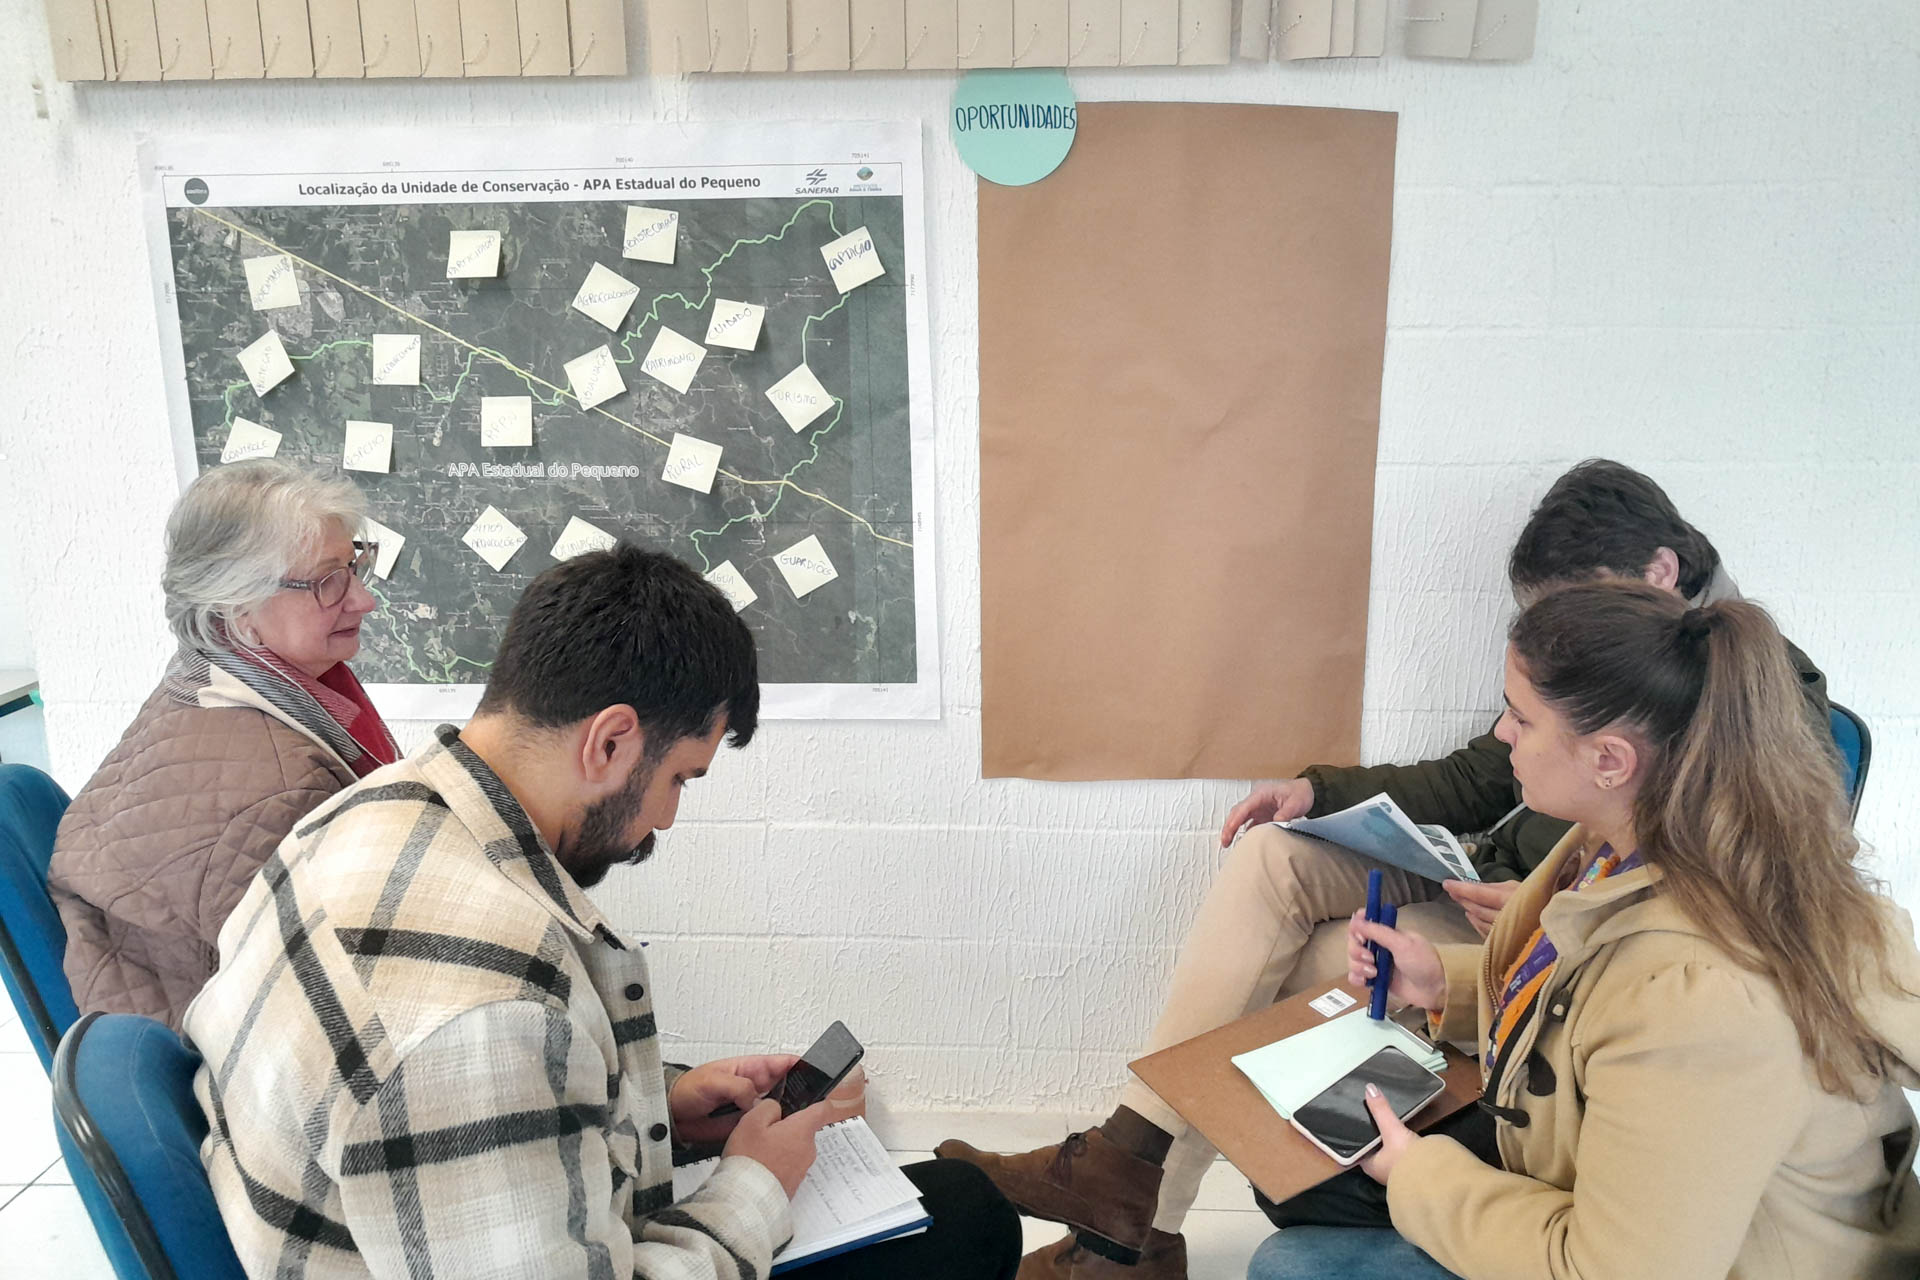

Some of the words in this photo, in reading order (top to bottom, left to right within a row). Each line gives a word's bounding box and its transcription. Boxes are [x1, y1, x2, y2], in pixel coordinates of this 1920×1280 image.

[955, 103, 1077, 132] OPORTUNIDADES
[299, 182, 378, 197] Localização
[381, 182, 398, 194] da
[401, 180, 458, 194] Unidade
[461, 180, 479, 193] de
[482, 179, 570, 195] Conservação
[583, 178, 612, 190] APA
[615, 177, 675, 190] Estadual
[679, 176, 697, 189] do
[701, 176, 761, 191] Pequeno
[795, 186, 840, 194] SANEPAR
[708, 307, 752, 340] CUIDADO
[448, 462, 480, 478] APA
[481, 462, 545, 478] Estadual
[547, 462, 569, 478] do
[571, 463, 640, 481] Pequeno
[666, 454, 703, 480] RURAL
